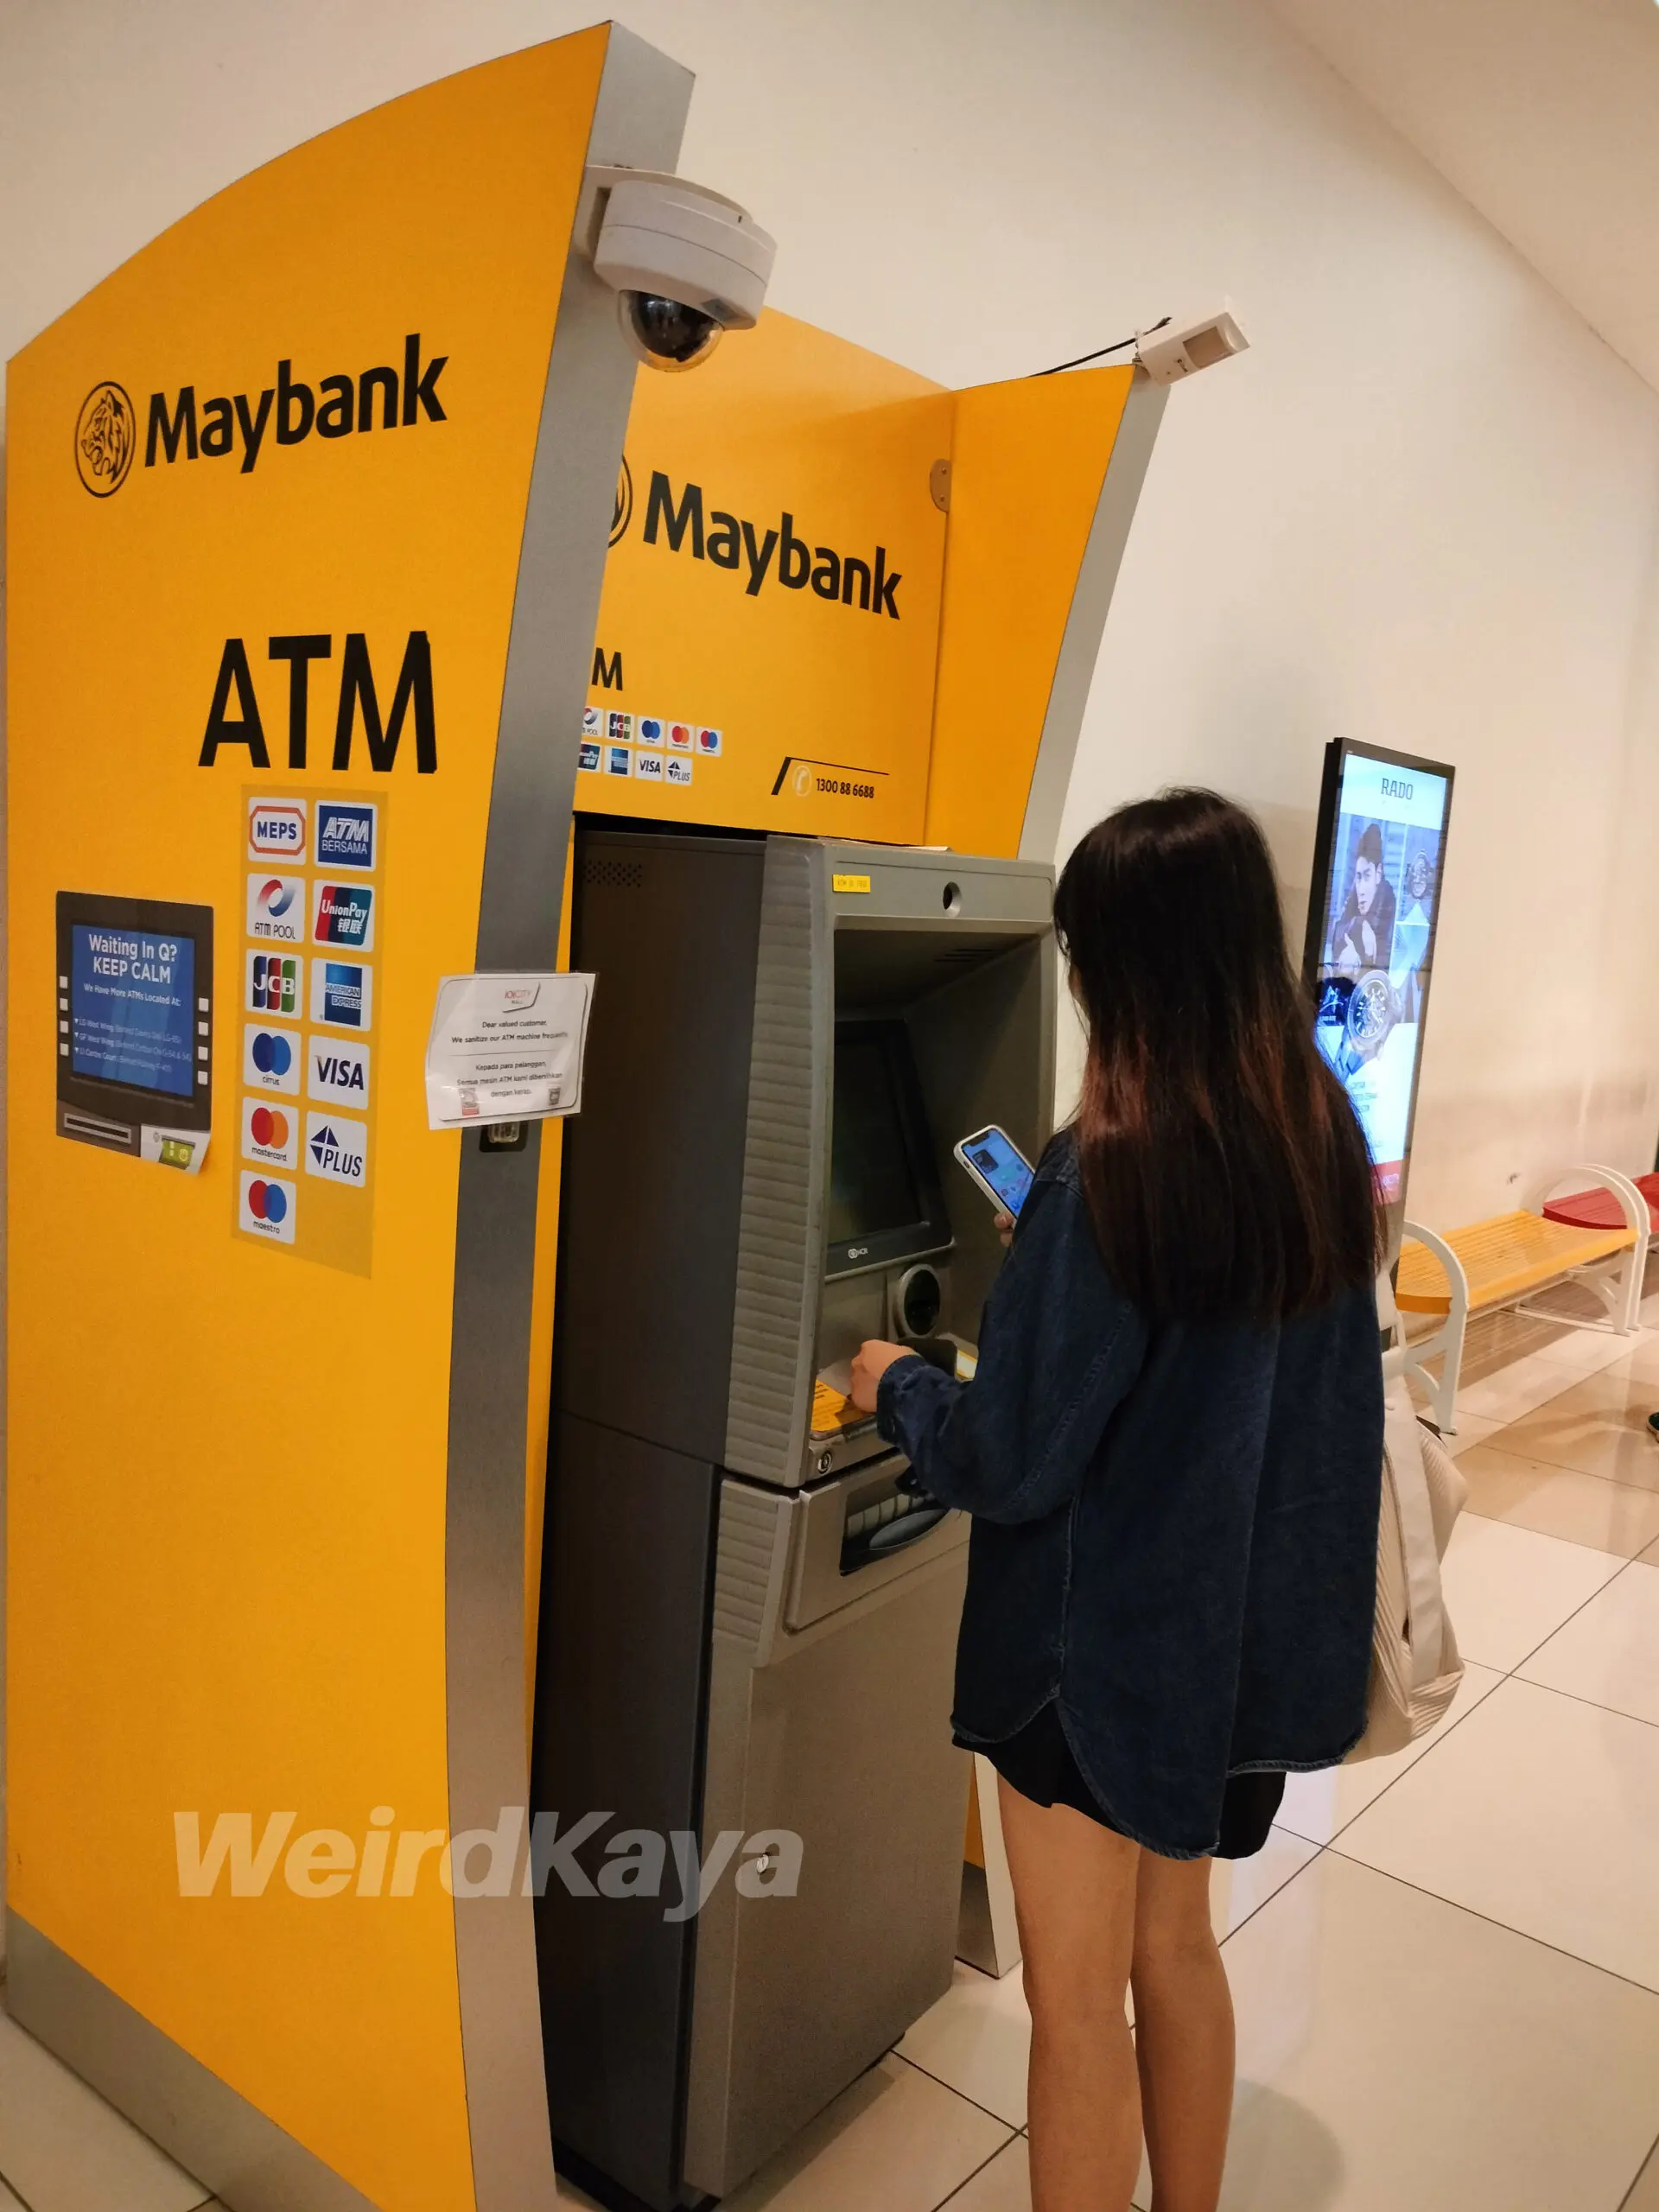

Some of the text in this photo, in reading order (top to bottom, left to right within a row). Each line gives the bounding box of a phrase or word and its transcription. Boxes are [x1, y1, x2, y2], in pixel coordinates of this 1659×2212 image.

[145, 333, 448, 474] Maybank
[643, 470, 902, 620] Maybank
[591, 647, 623, 691] M
[198, 631, 437, 774] ATM
[639, 760, 661, 774] VISA
[673, 768, 690, 782] PLUS
[816, 778, 874, 799] 1300 88 6688
[1380, 777, 1414, 801] RADO
[257, 821, 297, 840] MEPS
[322, 817, 370, 842] ATM
[321, 839, 368, 855] BERSAMA
[321, 899, 368, 923] UnionPay
[273, 925, 296, 940] POOL
[88, 933, 178, 962] Waiting In Q?
[92, 956, 171, 984] KEEP CALM
[84, 982, 95, 992] We
[95, 984, 109, 995] Have
[111, 987, 126, 998] More
[144, 991, 170, 1005] Located
[253, 973, 296, 995] JCB
[325, 983, 361, 997] AMERICAN
[332, 996, 362, 1008] EXPRESS
[262, 1076, 280, 1086] cirrus
[315, 1055, 365, 1090] VISA
[251, 1146, 287, 1162] mastercard
[322, 1148, 363, 1177] PLUS
[253, 1220, 281, 1235] maestro
